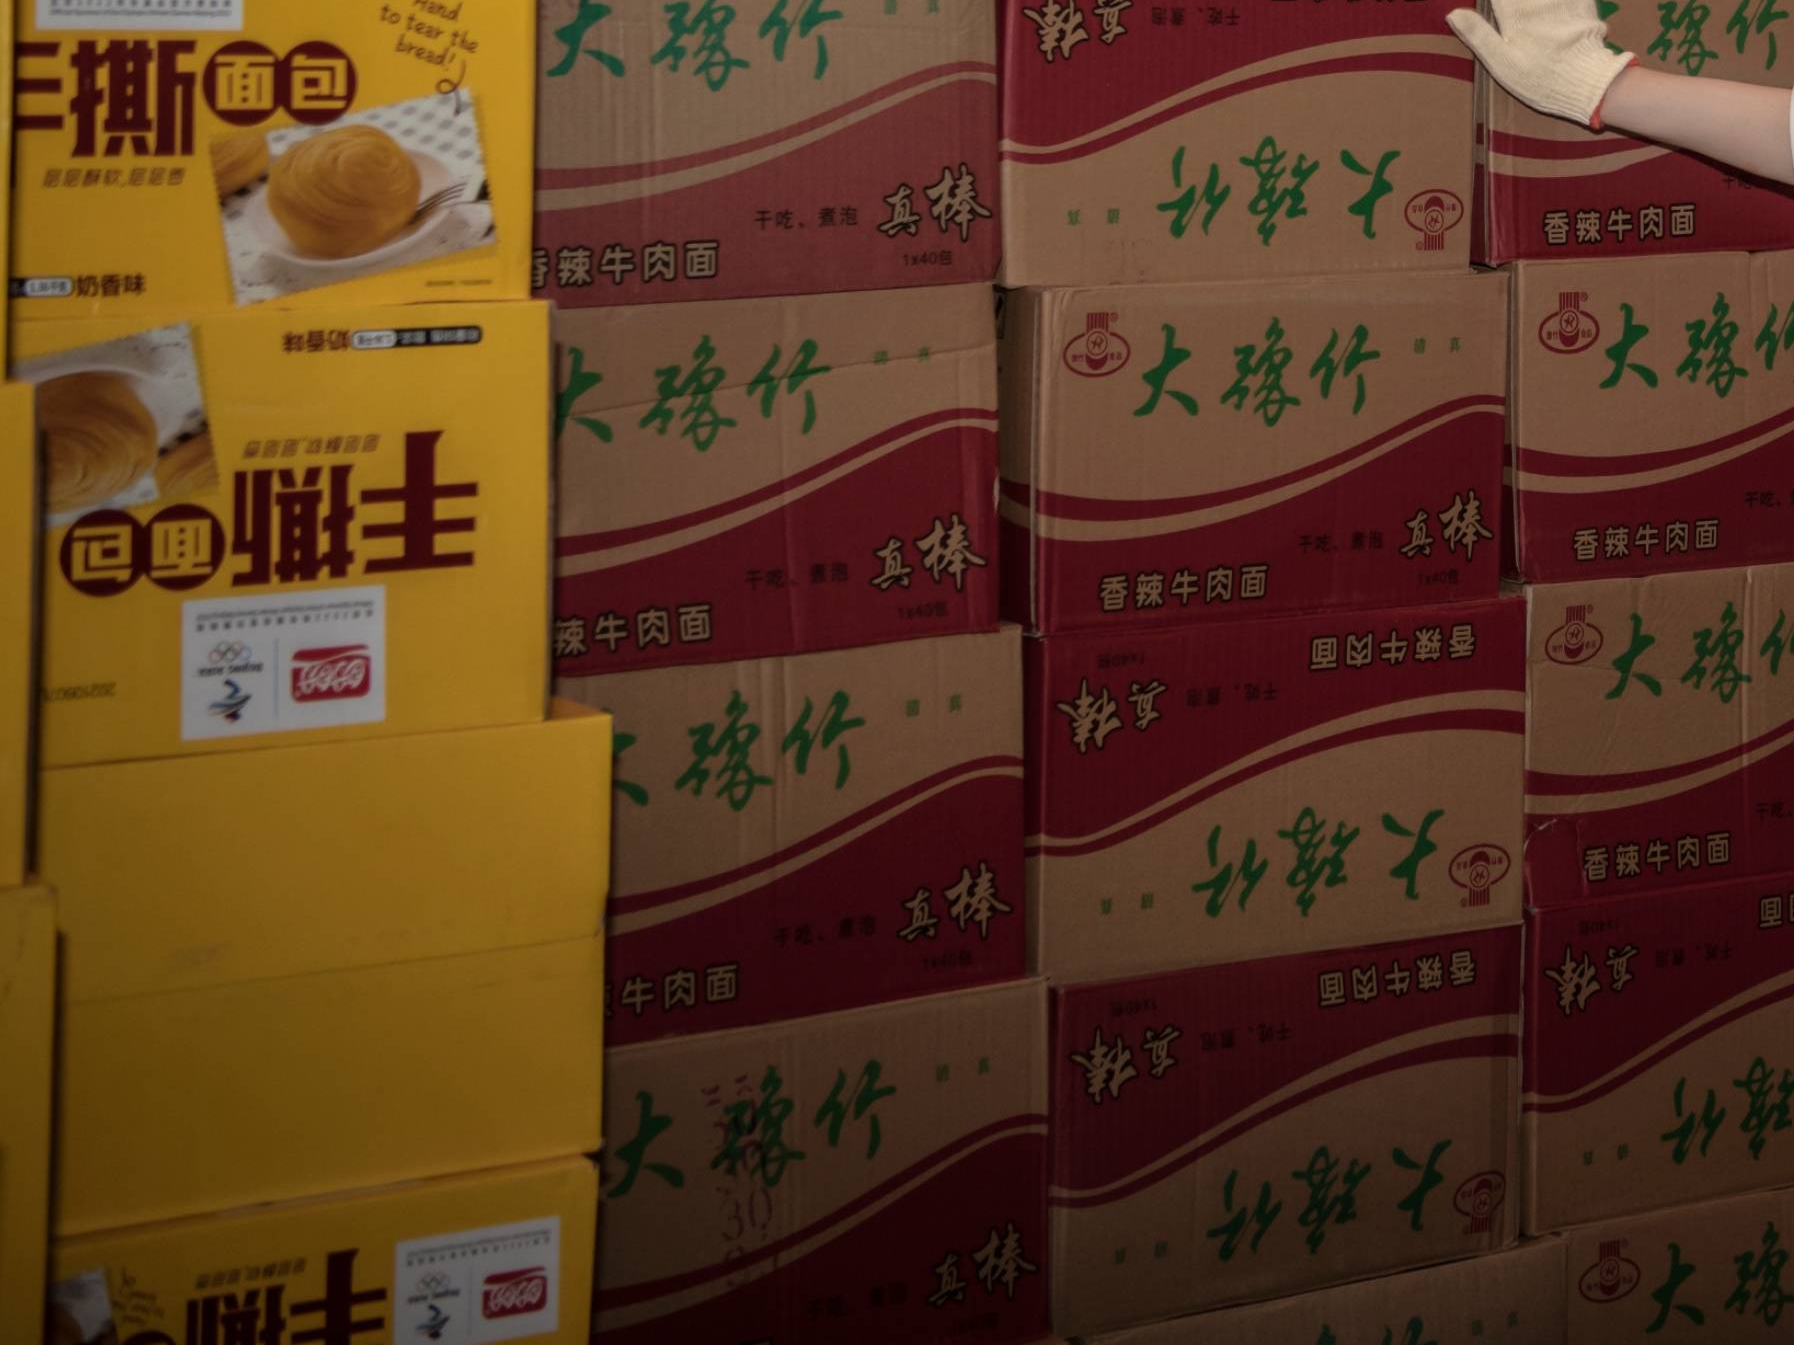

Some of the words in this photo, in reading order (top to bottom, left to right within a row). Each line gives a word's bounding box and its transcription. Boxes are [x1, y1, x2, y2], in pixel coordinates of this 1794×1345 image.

[379, 4, 401, 26] to
[405, 13, 447, 42] tear
[450, 29, 479, 54] the
[877, 163, 992, 242] 真棒
[1543, 202, 1697, 246] 香辣牛肉面
[76, 274, 147, 297] 奶香味
[283, 329, 352, 353] 奶香味
[60, 431, 478, 597] 手撕面包
[1399, 490, 1494, 560] 真棒
[1573, 518, 1720, 561] 香辣牛肉面
[1099, 563, 1270, 613] 香辣牛肉面
[1309, 624, 1477, 671] 香辣牛肉面
[1583, 830, 1733, 883] 香辣牛肉面
[605, 961, 740, 1019] 牛肉面
[1318, 949, 1477, 1008] 香辣牛肉面
